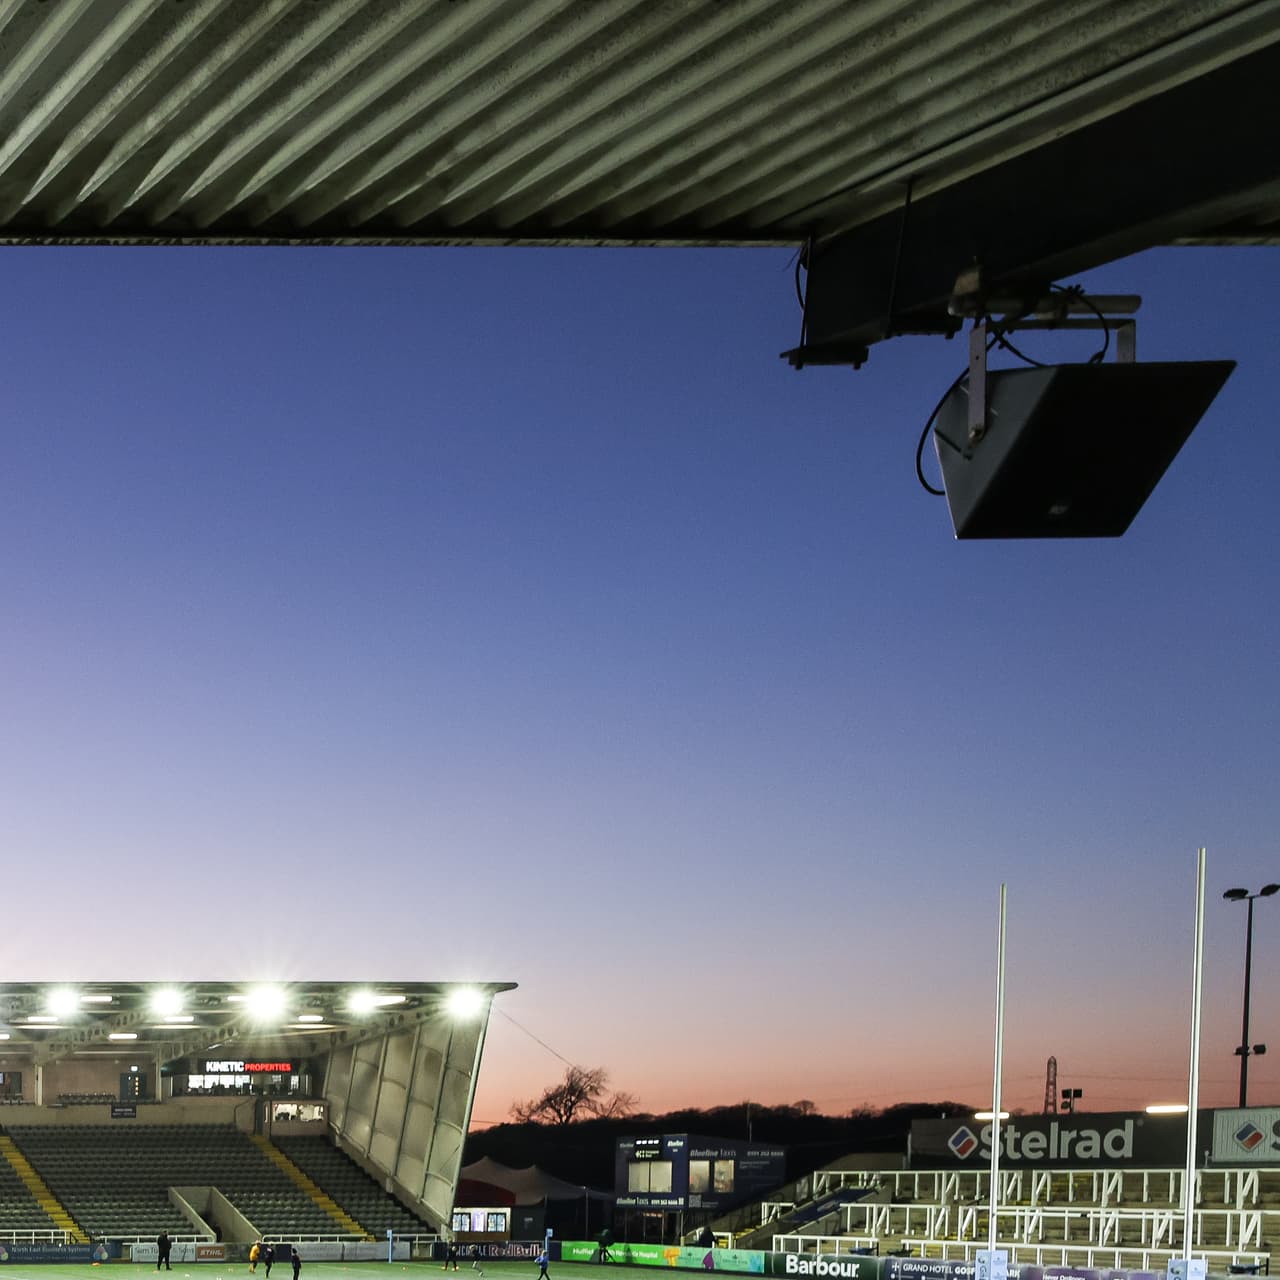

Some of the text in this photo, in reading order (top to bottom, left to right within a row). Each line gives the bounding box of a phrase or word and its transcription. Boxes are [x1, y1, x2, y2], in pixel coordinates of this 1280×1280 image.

[206, 1061, 292, 1072] KINETIC PROPERTIES
[979, 1119, 1133, 1160] Stelrad
[903, 1263, 929, 1273] GRAND
[929, 1265, 953, 1274] HOTEL
